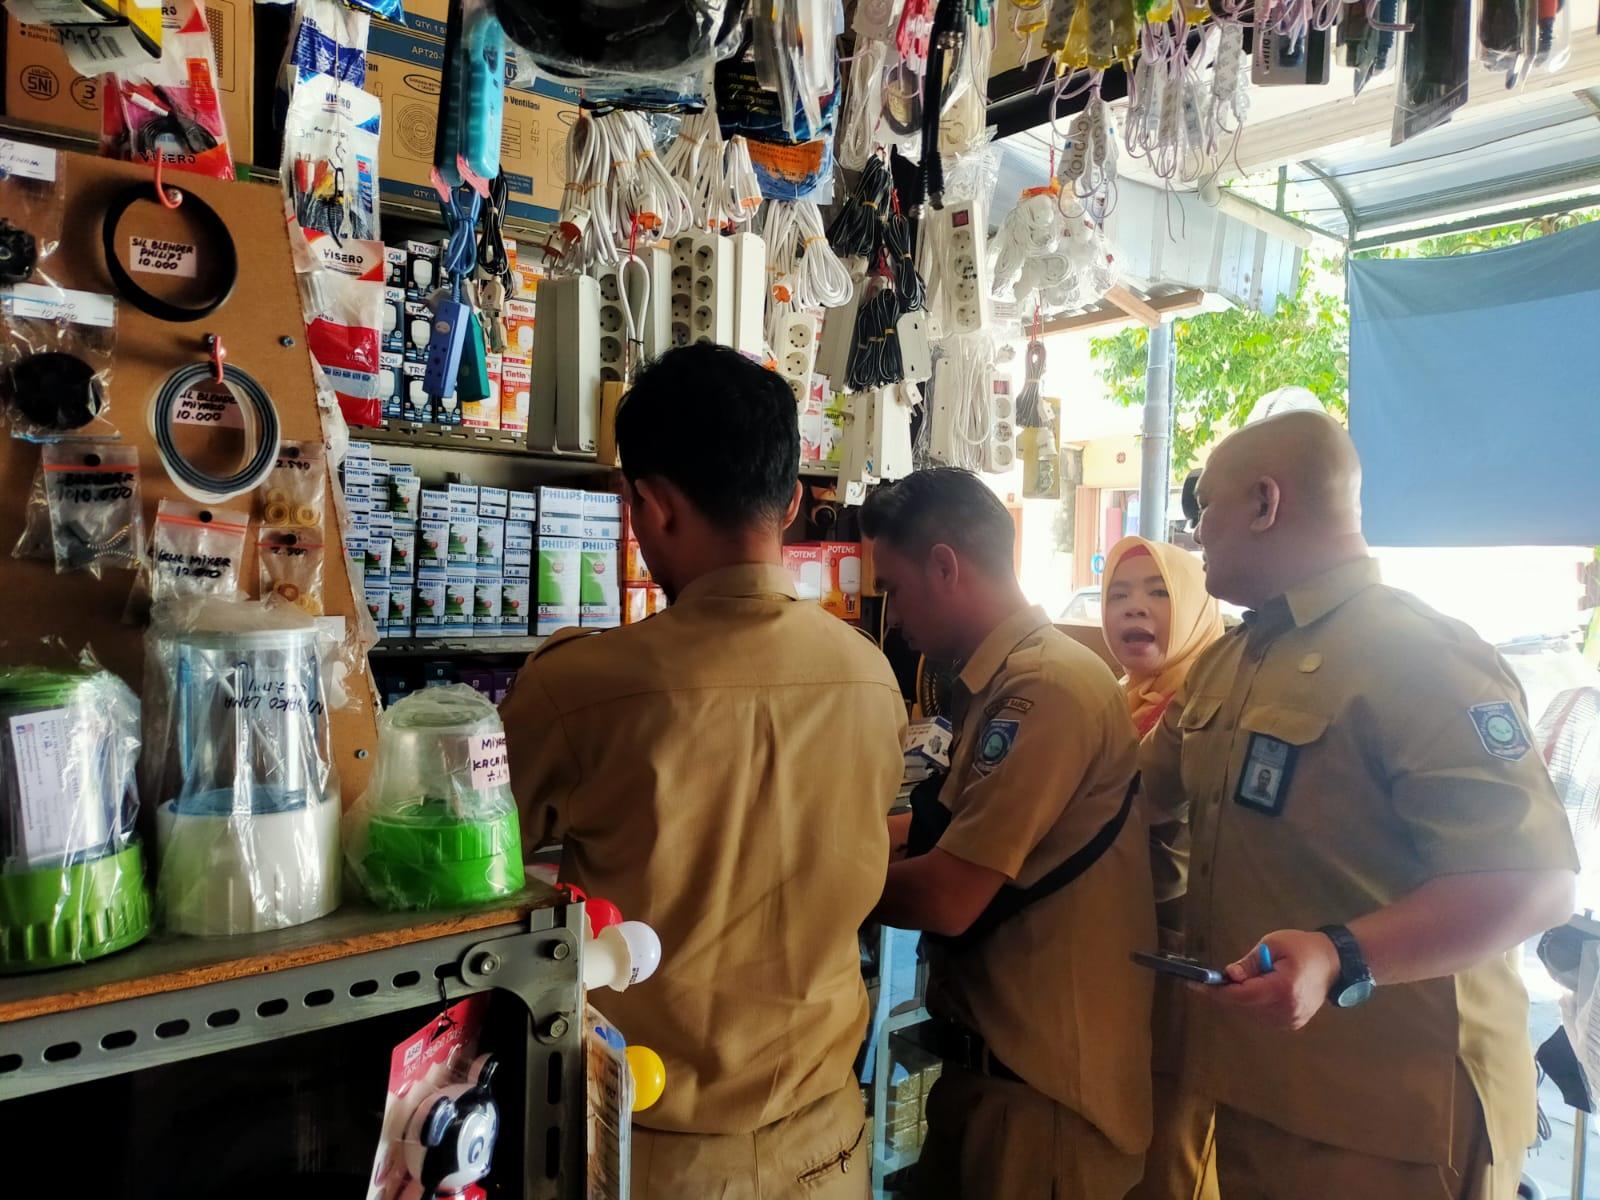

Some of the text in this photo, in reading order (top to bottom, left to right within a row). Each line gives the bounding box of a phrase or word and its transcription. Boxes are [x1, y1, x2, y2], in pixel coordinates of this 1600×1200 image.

[28, 78, 52, 92] SNI
[83, 85, 95, 98] 3
[510, 96, 540, 111] Ventilasi
[151, 241, 194, 254] BLENDER
[412, 244, 437, 255] TRON
[324, 248, 364, 264] VISERO
[138, 258, 178, 270] 10.000
[510, 304, 530, 312] Tintin
[505, 370, 526, 379] Tintin
[176, 410, 221, 421] 10.000
[542, 490, 582, 500] PHILIPS
[584, 495, 622, 504] PHILIPS
[542, 540, 579, 549] PHILIPS
[582, 542, 620, 550] PHILIPS
[790, 550, 816, 558] POTENS
